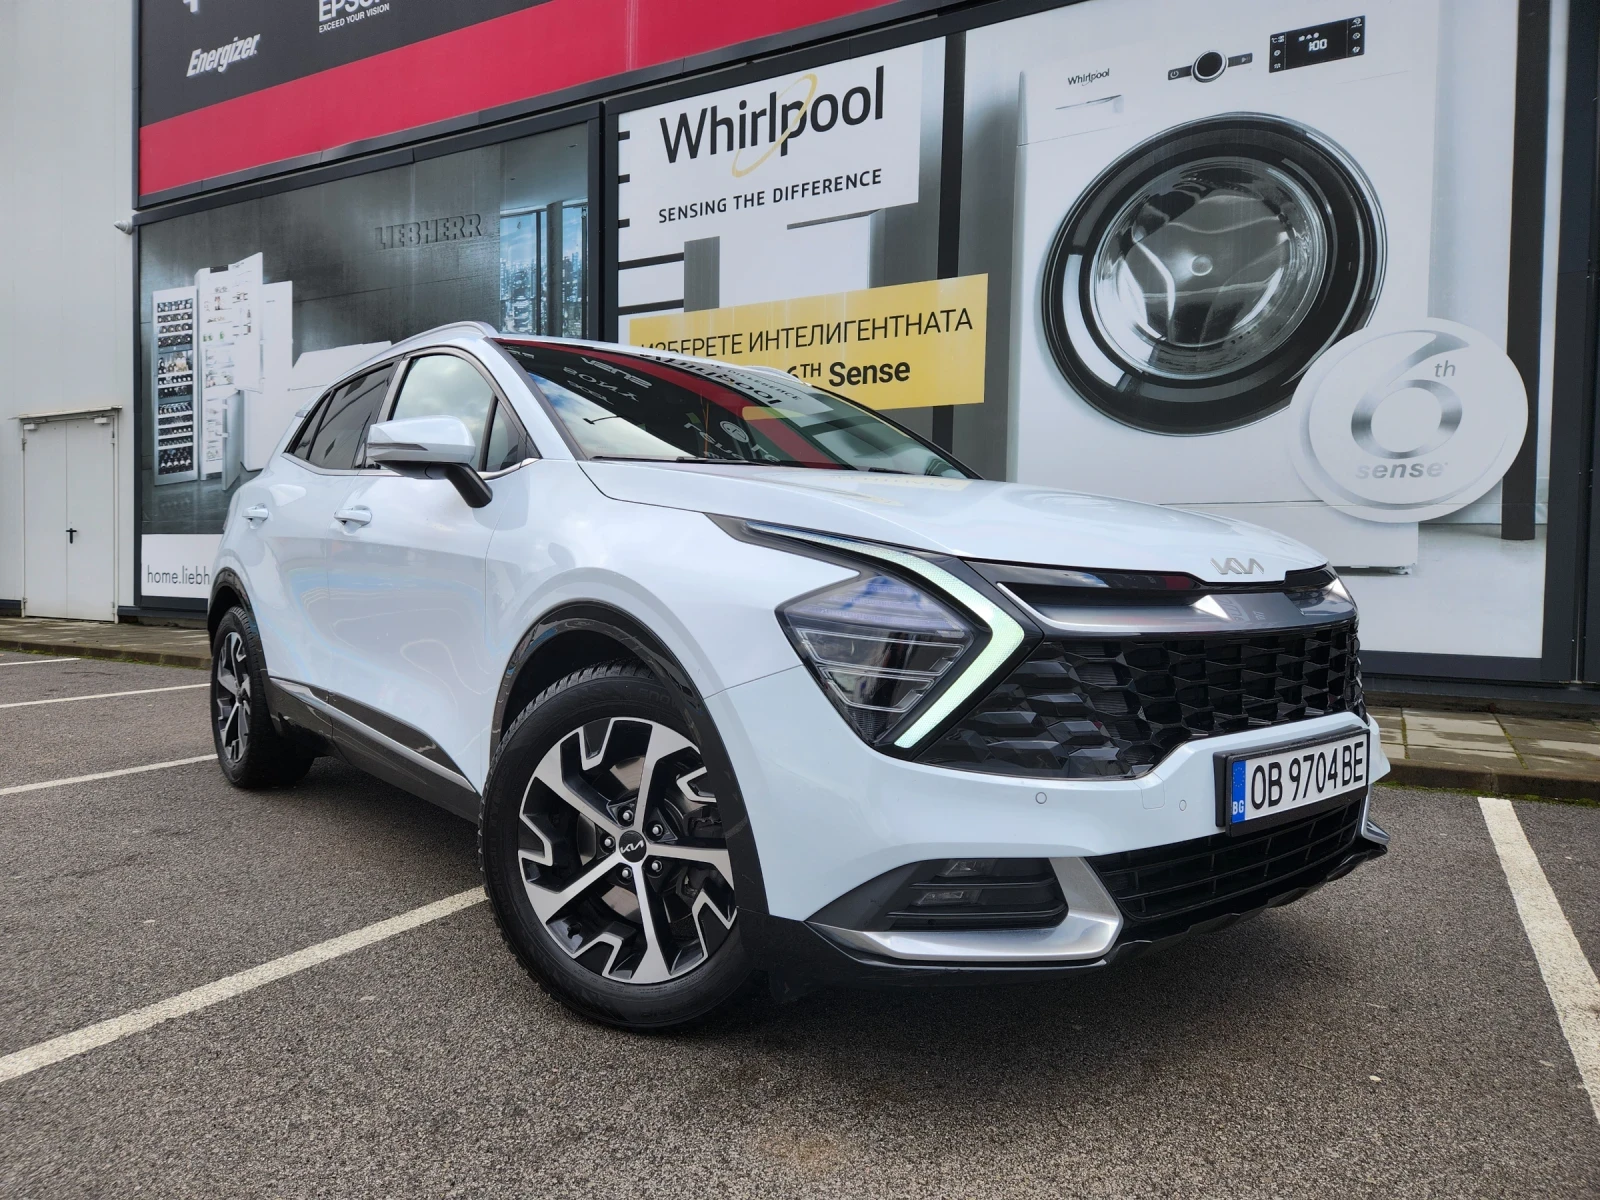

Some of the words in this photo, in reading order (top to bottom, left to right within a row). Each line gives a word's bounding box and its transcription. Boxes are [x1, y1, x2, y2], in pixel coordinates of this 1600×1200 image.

[318, 18, 345, 33] EXCEED
[346, 11, 365, 24] YOUR
[366, 2, 390, 17] VISION
[186, 34, 261, 77] Energizer
[1067, 68, 1110, 84] Whirlpool
[659, 65, 885, 164] Whirlpool
[658, 198, 727, 223] SENSING
[733, 190, 765, 210] THE
[773, 168, 882, 203] DIFFERENCE
[375, 213, 482, 250] LIEBHERR
[749, 307, 974, 352] ИНТЕЛИГЕНТНАТА
[829, 360, 911, 388] Sense
[1355, 462, 1446, 480] sense
[147, 564, 211, 585] home.liebh
[1251, 762, 1283, 810] OB
[1289, 748, 1338, 801] 9704
[1342, 741, 1364, 787] BE
[1232, 801, 1245, 815] BG
